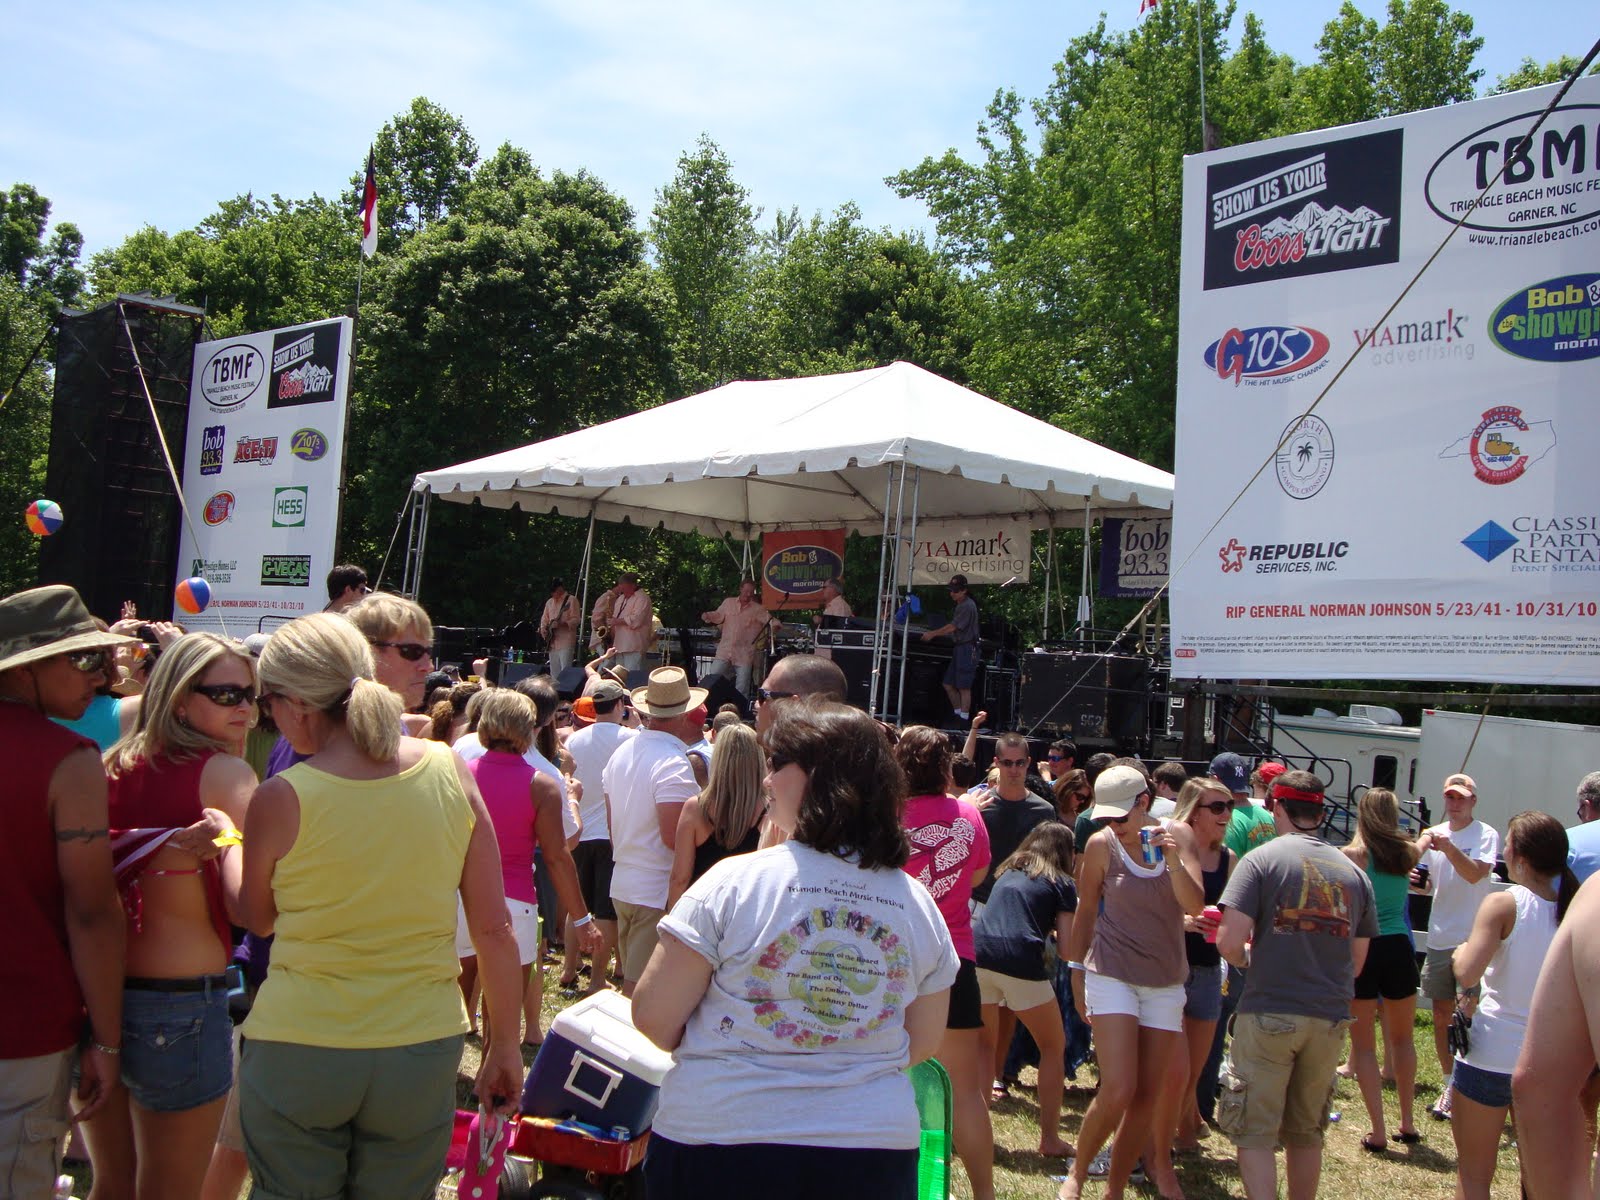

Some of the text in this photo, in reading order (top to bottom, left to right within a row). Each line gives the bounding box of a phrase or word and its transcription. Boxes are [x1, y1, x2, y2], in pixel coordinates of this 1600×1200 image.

[1466, 123, 1600, 190] TBM
[1213, 161, 1327, 222] SHOW US YOUR
[1450, 194, 1503, 213] TRIANGLE
[1506, 188, 1543, 204] BEACH
[1546, 181, 1583, 197] MUSIC
[1508, 202, 1577, 222] GARNER, NC
[1469, 219, 1600, 246] www.trianglebeach.co
[1234, 217, 1392, 272] Coors LIGHT
[1527, 284, 1584, 309] Bob
[274, 337, 315, 368] SHOW US YOUR
[1216, 327, 1300, 386] G105
[1372, 343, 1475, 366] advertising
[212, 352, 255, 384] TBMF
[1272, 375, 1296, 385] MUSIC
[1297, 359, 1330, 380] CHANNEL
[304, 374, 334, 393] LIGHT
[1287, 419, 1324, 435] ORTH
[204, 429, 223, 450] bob
[277, 499, 303, 515] HESS
[1512, 516, 1600, 533] CLASSI
[1125, 523, 1169, 552] bob
[781, 552, 808, 564] Bob
[1249, 541, 1349, 561] REPUBLIC
[1512, 548, 1600, 563] RENTA
[262, 561, 310, 577] G-VEGAS
[926, 557, 1024, 574] advertising
[1124, 552, 1168, 575] 93.3
[1256, 561, 1338, 574] SERVICES, INC.
[1511, 564, 1548, 573] EVENT
[793, 580, 825, 588] morning
[221, 600, 239, 608] NORMAN
[239, 600, 258, 608] JOHNSON
[258, 601, 278, 609] 5/23/41
[280, 601, 304, 610] 10/31/10
[1226, 606, 1246, 618] RIP
[1249, 605, 1306, 618] GENERAL
[1310, 604, 1366, 617] NORMAN
[1369, 603, 1432, 617] JOHNSON
[1436, 602, 1502, 617] 5/23/41
[1516, 602, 1598, 617] 10/31/10
[911, 823, 949, 841] CAROLINA
[787, 886, 905, 910] Triangle Beach Music Festival
[856, 955, 879, 965] Board
[802, 1006, 860, 1023] The Main Event
[847, 1001, 869, 1010] Dollar
